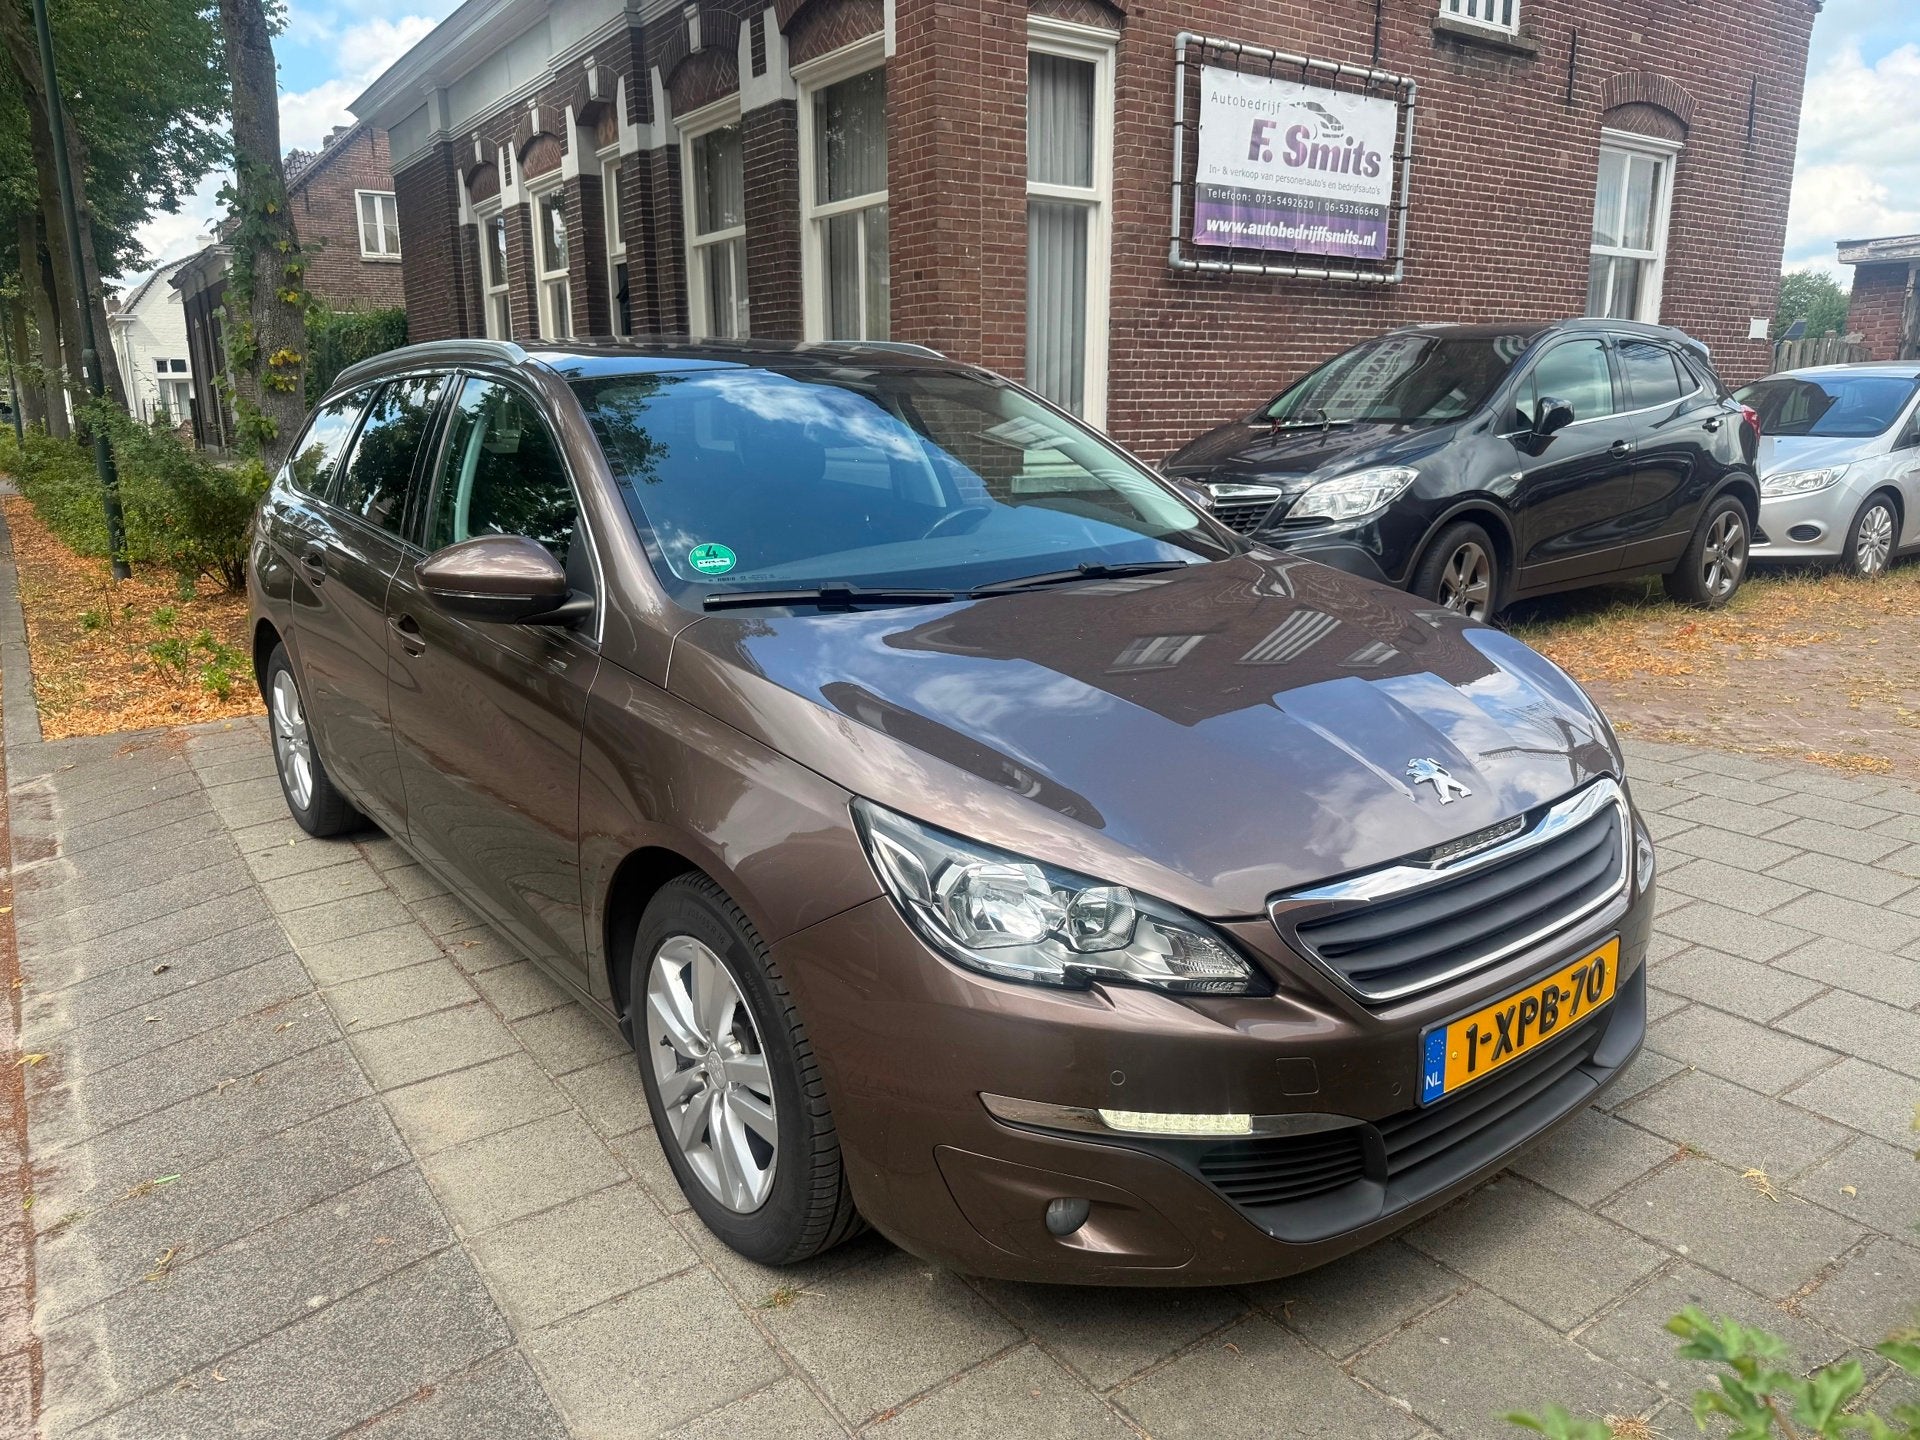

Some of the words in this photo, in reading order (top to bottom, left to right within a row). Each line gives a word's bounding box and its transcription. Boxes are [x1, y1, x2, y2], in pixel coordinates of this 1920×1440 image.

[1210, 91, 1281, 115] Autobedrijf
[1247, 118, 1277, 163] F.
[1282, 124, 1382, 178] Smits
[1229, 168, 1259, 182] verkoop
[1261, 173, 1274, 181] van
[1275, 175, 1327, 189] personenauto's
[1337, 181, 1381, 195] bedrijfsauto's
[1207, 188, 1251, 202] Telefoon:
[1255, 193, 1314, 209] 073-5492620
[1324, 202, 1380, 217] 06-53266648
[1206, 218, 1377, 247] www.autobedrijffsmits.nl
[705, 545, 718, 559] 4
[1465, 956, 1606, 1073] 1-XPB-70
[1425, 1071, 1442, 1090] NL
